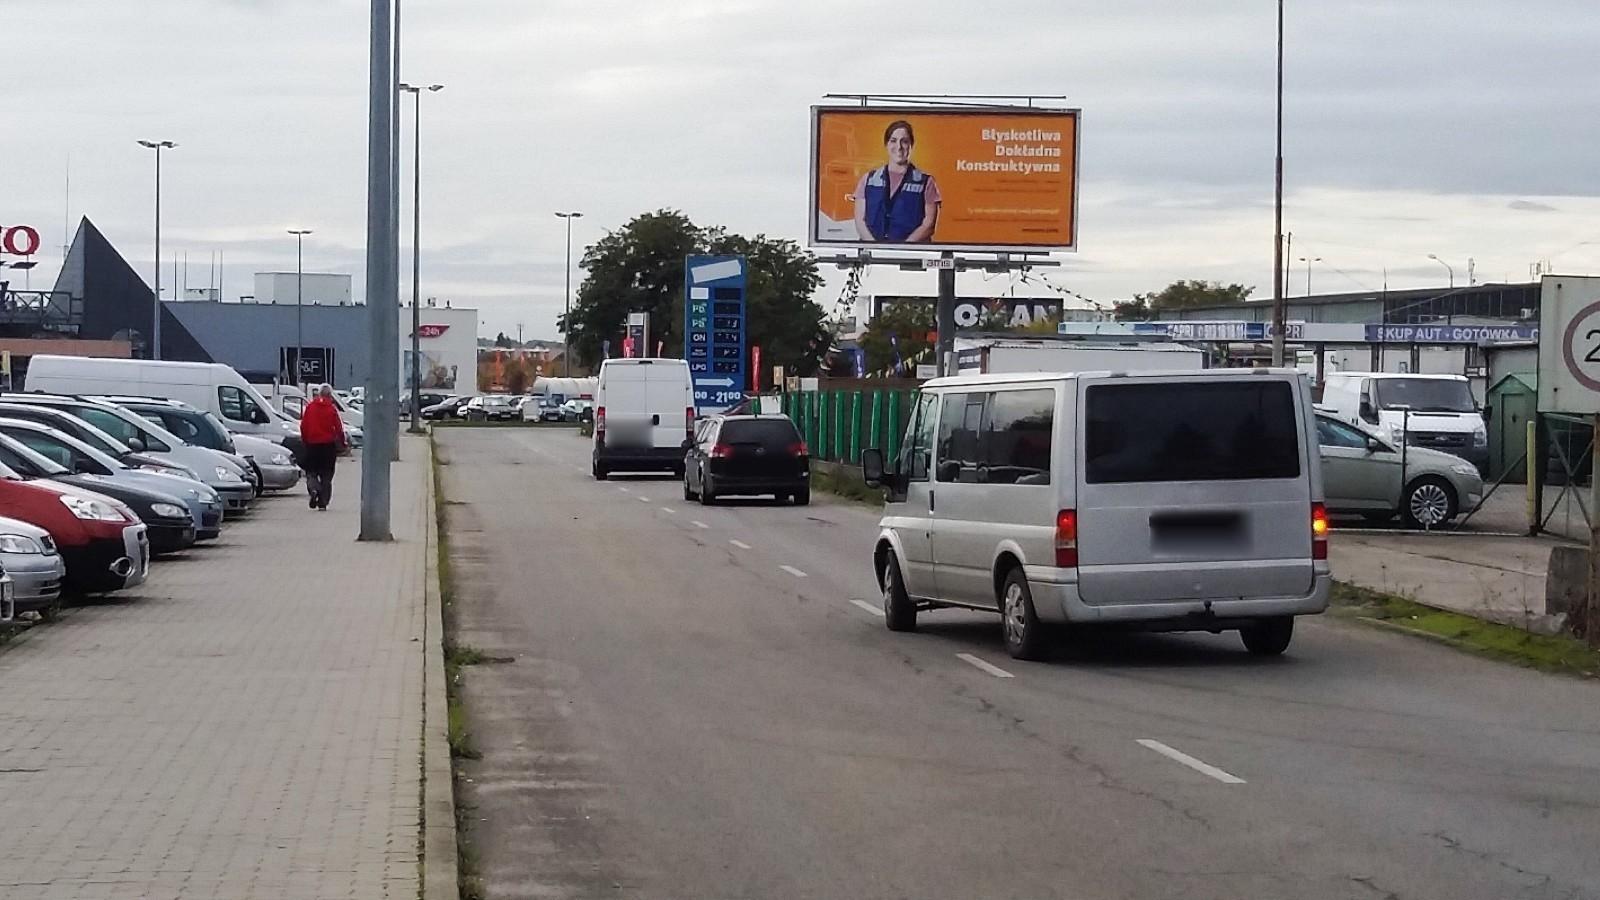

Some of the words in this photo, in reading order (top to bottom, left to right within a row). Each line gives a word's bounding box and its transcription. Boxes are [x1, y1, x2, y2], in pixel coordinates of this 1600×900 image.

[981, 128, 1061, 143] Błyskotliwa
[995, 144, 1061, 157] Dokładna
[956, 159, 1061, 175] Konstruktywna
[0, 225, 40, 255] O
[693, 334, 706, 342] ON
[1265, 325, 1304, 338] CPRI
[1377, 327, 1413, 340] SKUP
[1415, 328, 1442, 340] AUT
[1453, 326, 1520, 340] GOTÓWKA
